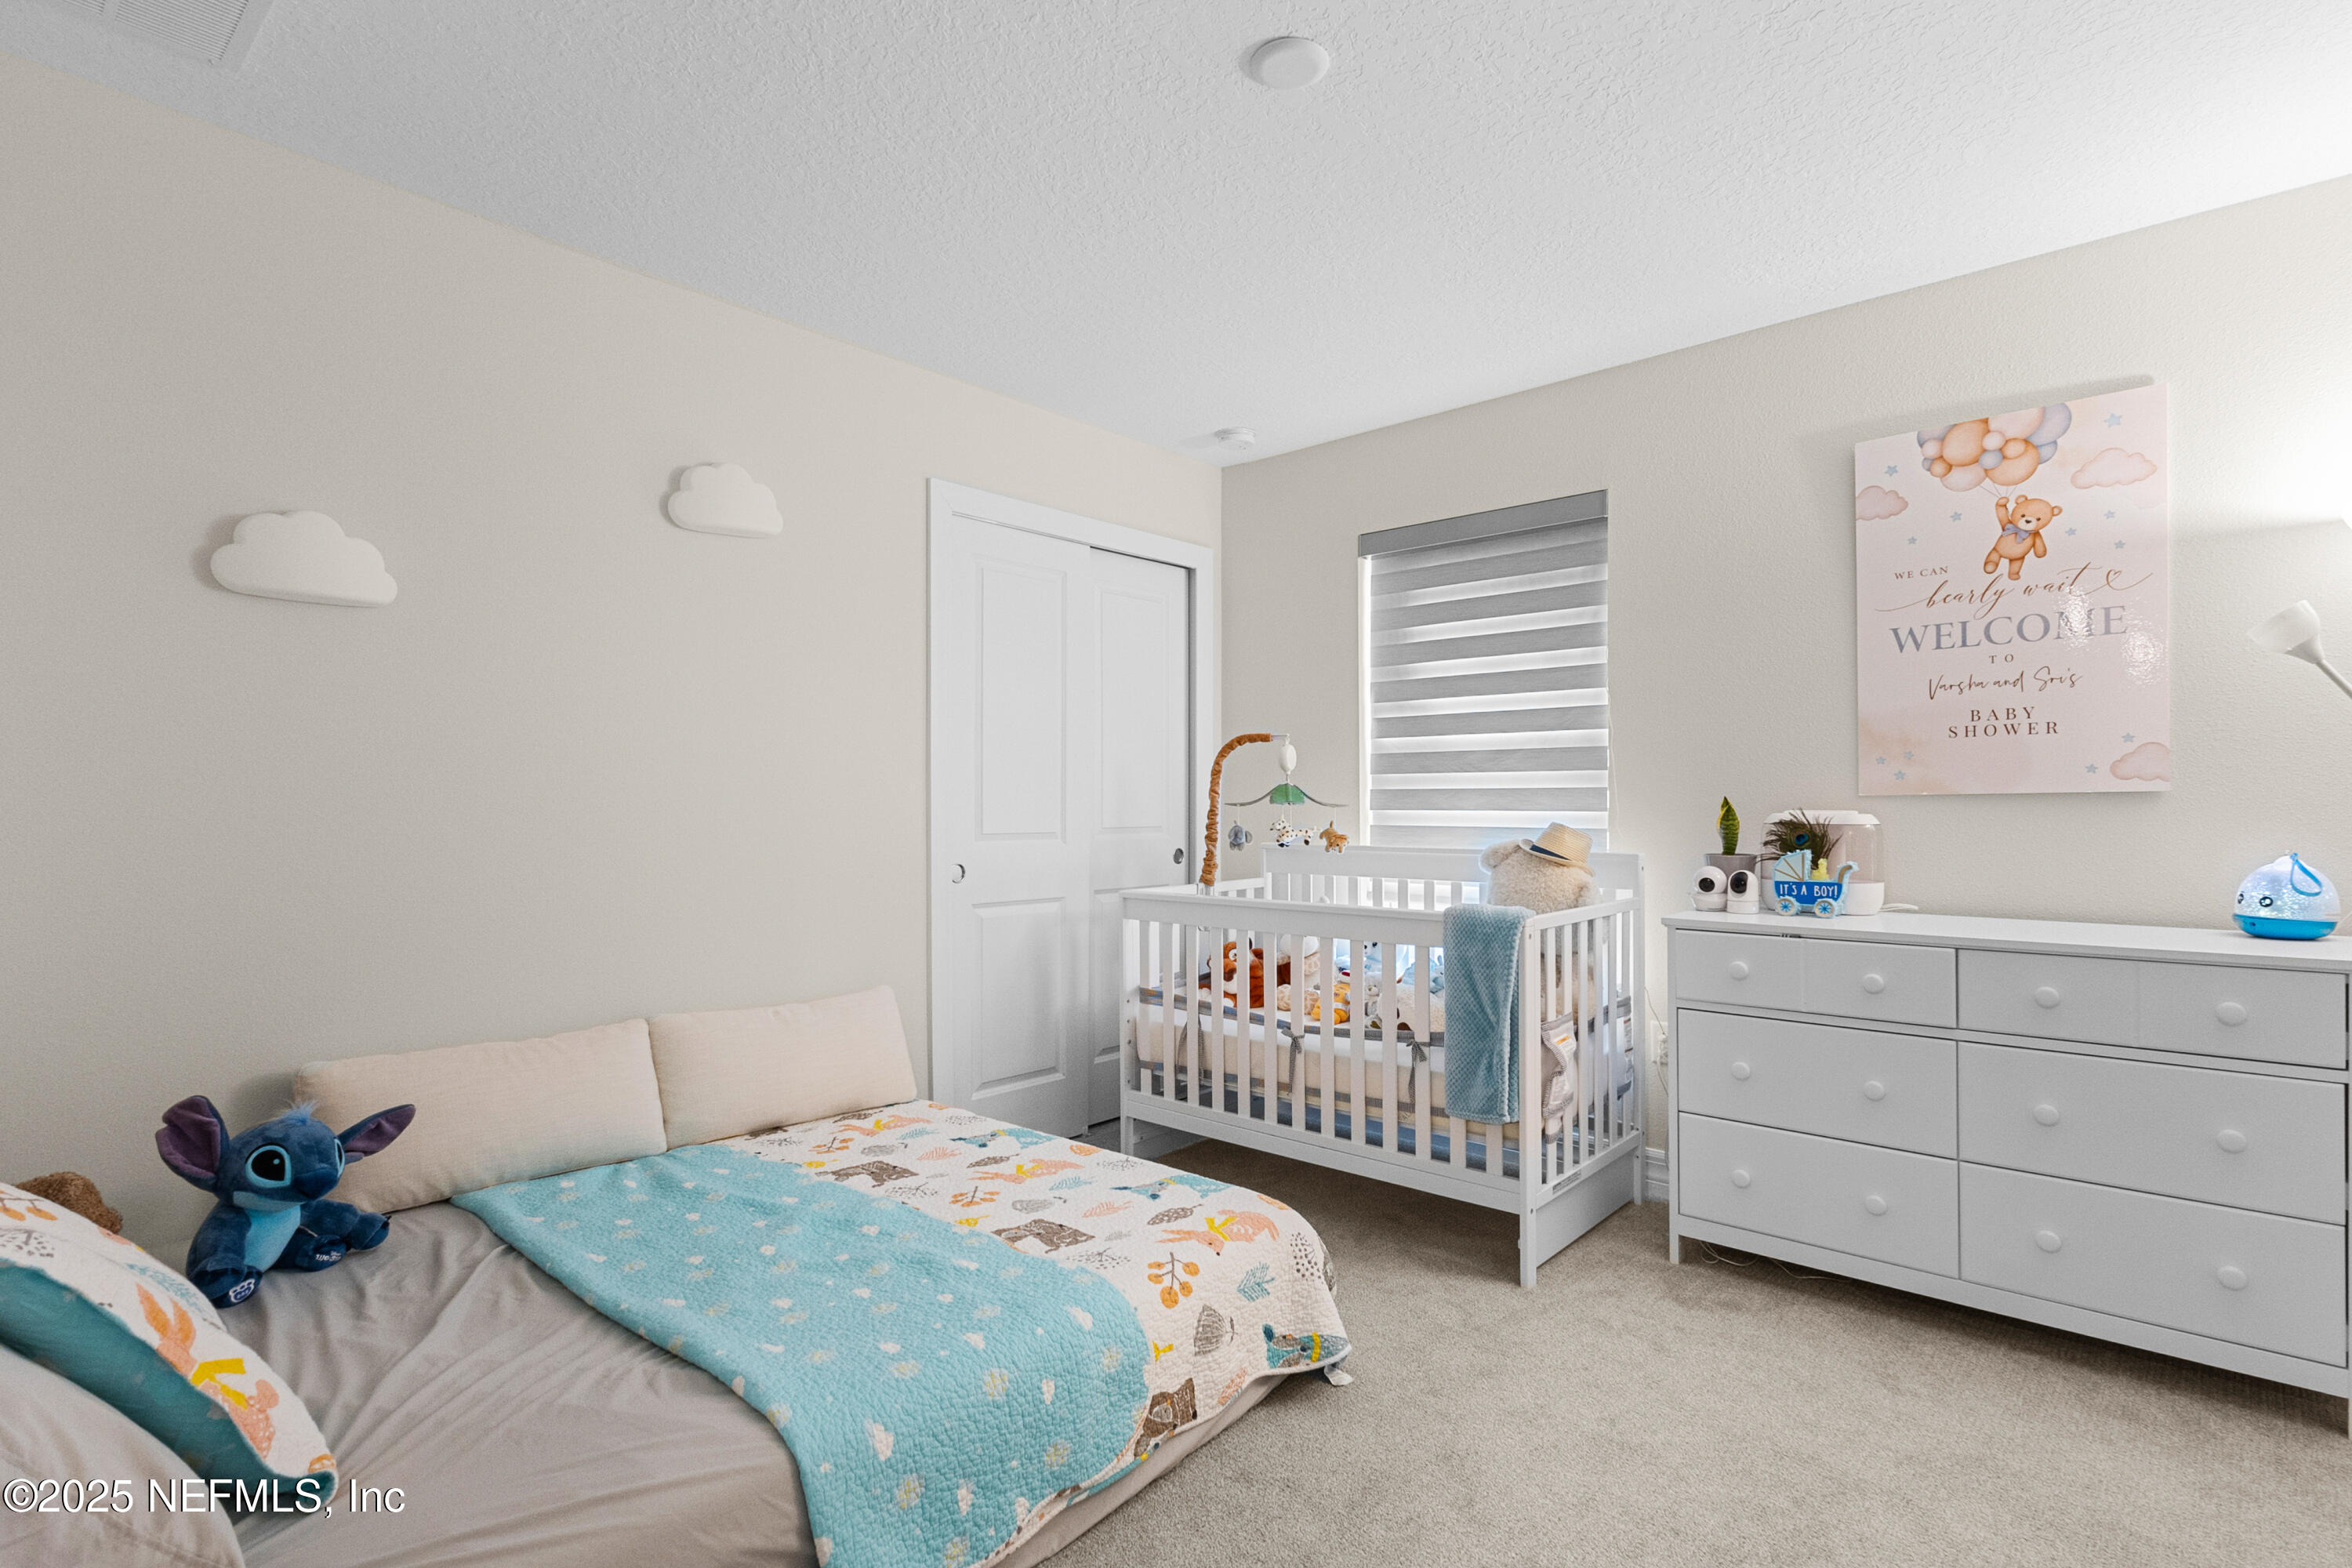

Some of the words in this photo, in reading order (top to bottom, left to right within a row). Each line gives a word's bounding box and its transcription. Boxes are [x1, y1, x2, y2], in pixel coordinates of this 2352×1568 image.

[1893, 570, 1915, 580] WE
[1919, 565, 1949, 577] CAN
[1875, 573, 2015, 620] bearly
[2023, 561, 2103, 597] wait
[1889, 605, 2128, 655] WELCOME
[1988, 654, 2015, 664] TO
[1928, 674, 1989, 700] Varsha
[1992, 670, 2024, 692] and
[2033, 666, 2083, 691] Sri's
[1970, 706, 2036, 722] BABY
[1948, 721, 2059, 739] SHOWER
[1779, 882, 1798, 896] IT'S
[1800, 884, 1808, 896] A
[1813, 884, 1838, 898] BOY!
